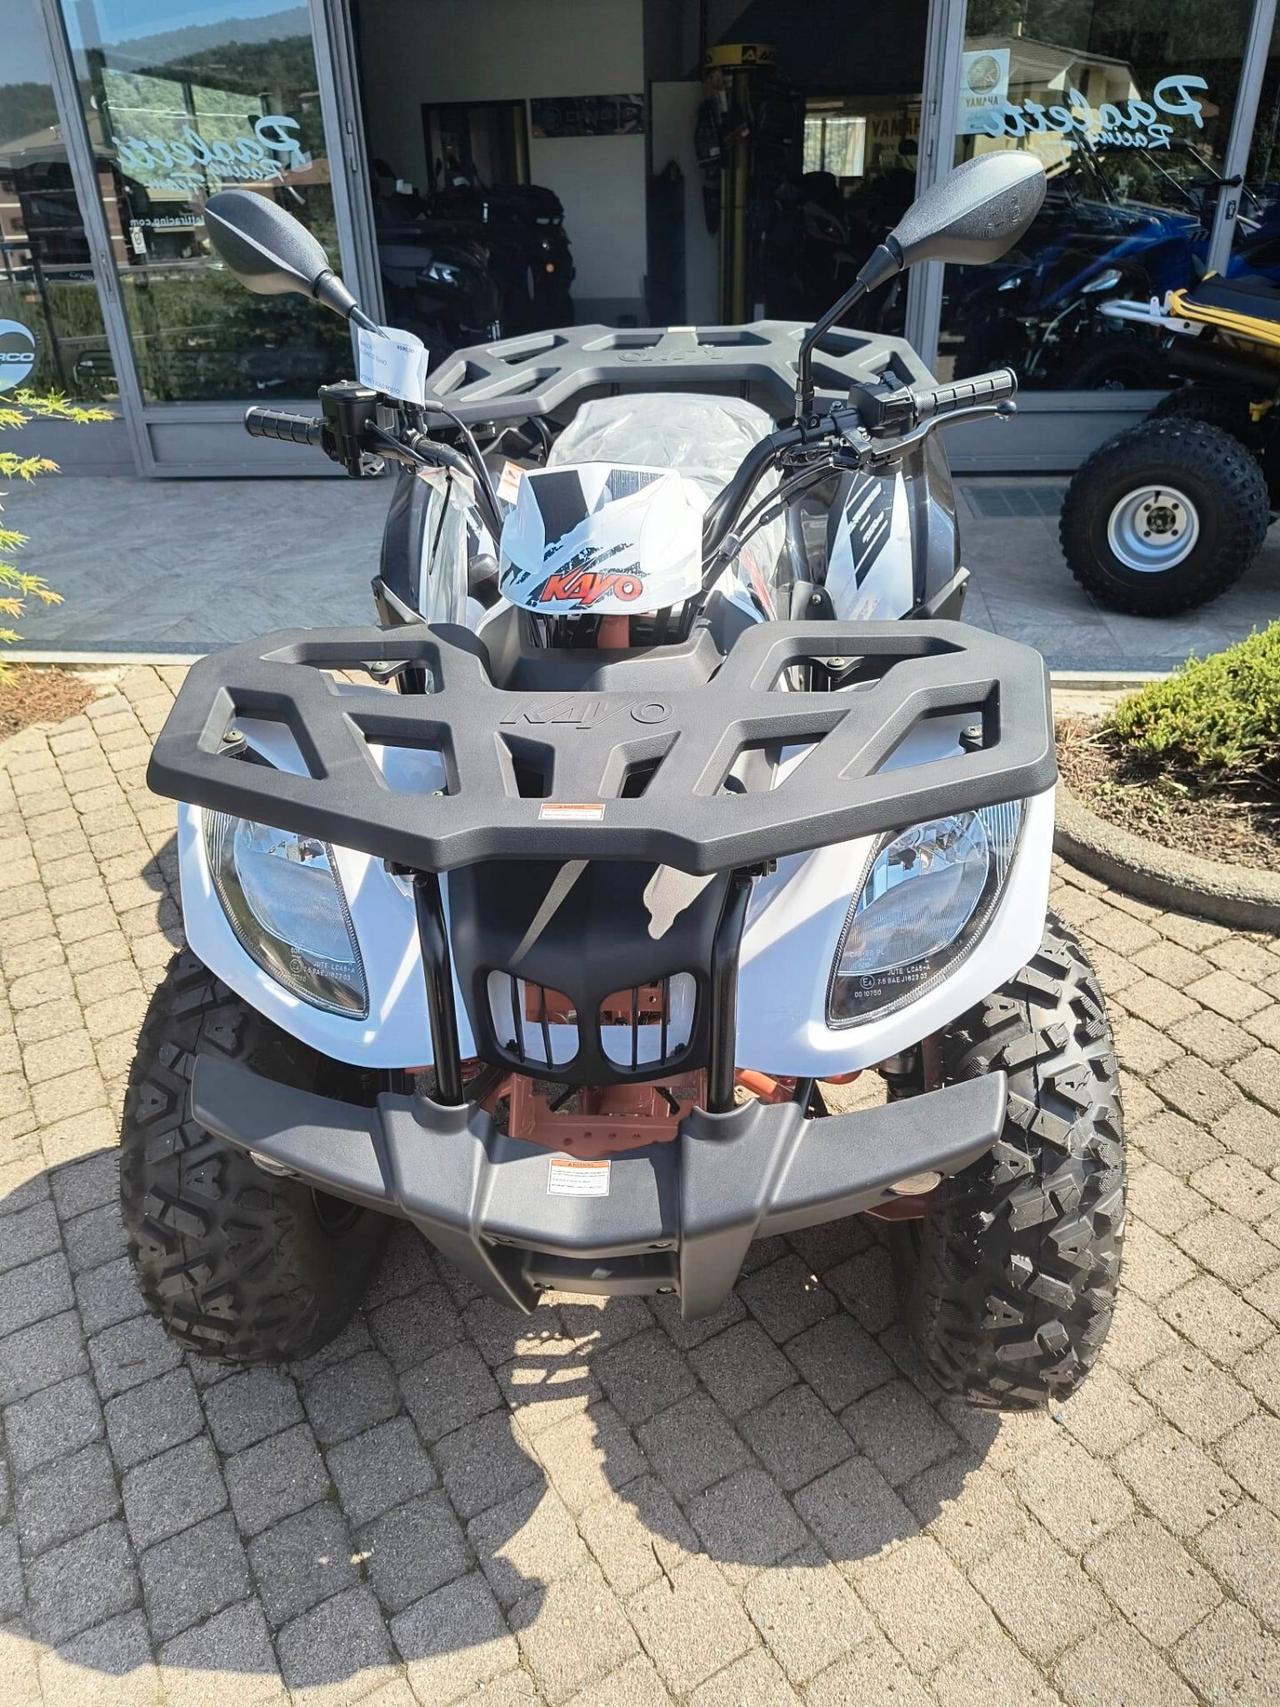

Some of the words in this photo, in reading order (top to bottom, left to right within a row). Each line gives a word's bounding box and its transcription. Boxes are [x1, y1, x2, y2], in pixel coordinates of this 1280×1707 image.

[965, 96, 999, 108] YAMAHA
[539, 564, 643, 605] KAYO
[499, 695, 673, 730] KAYO
